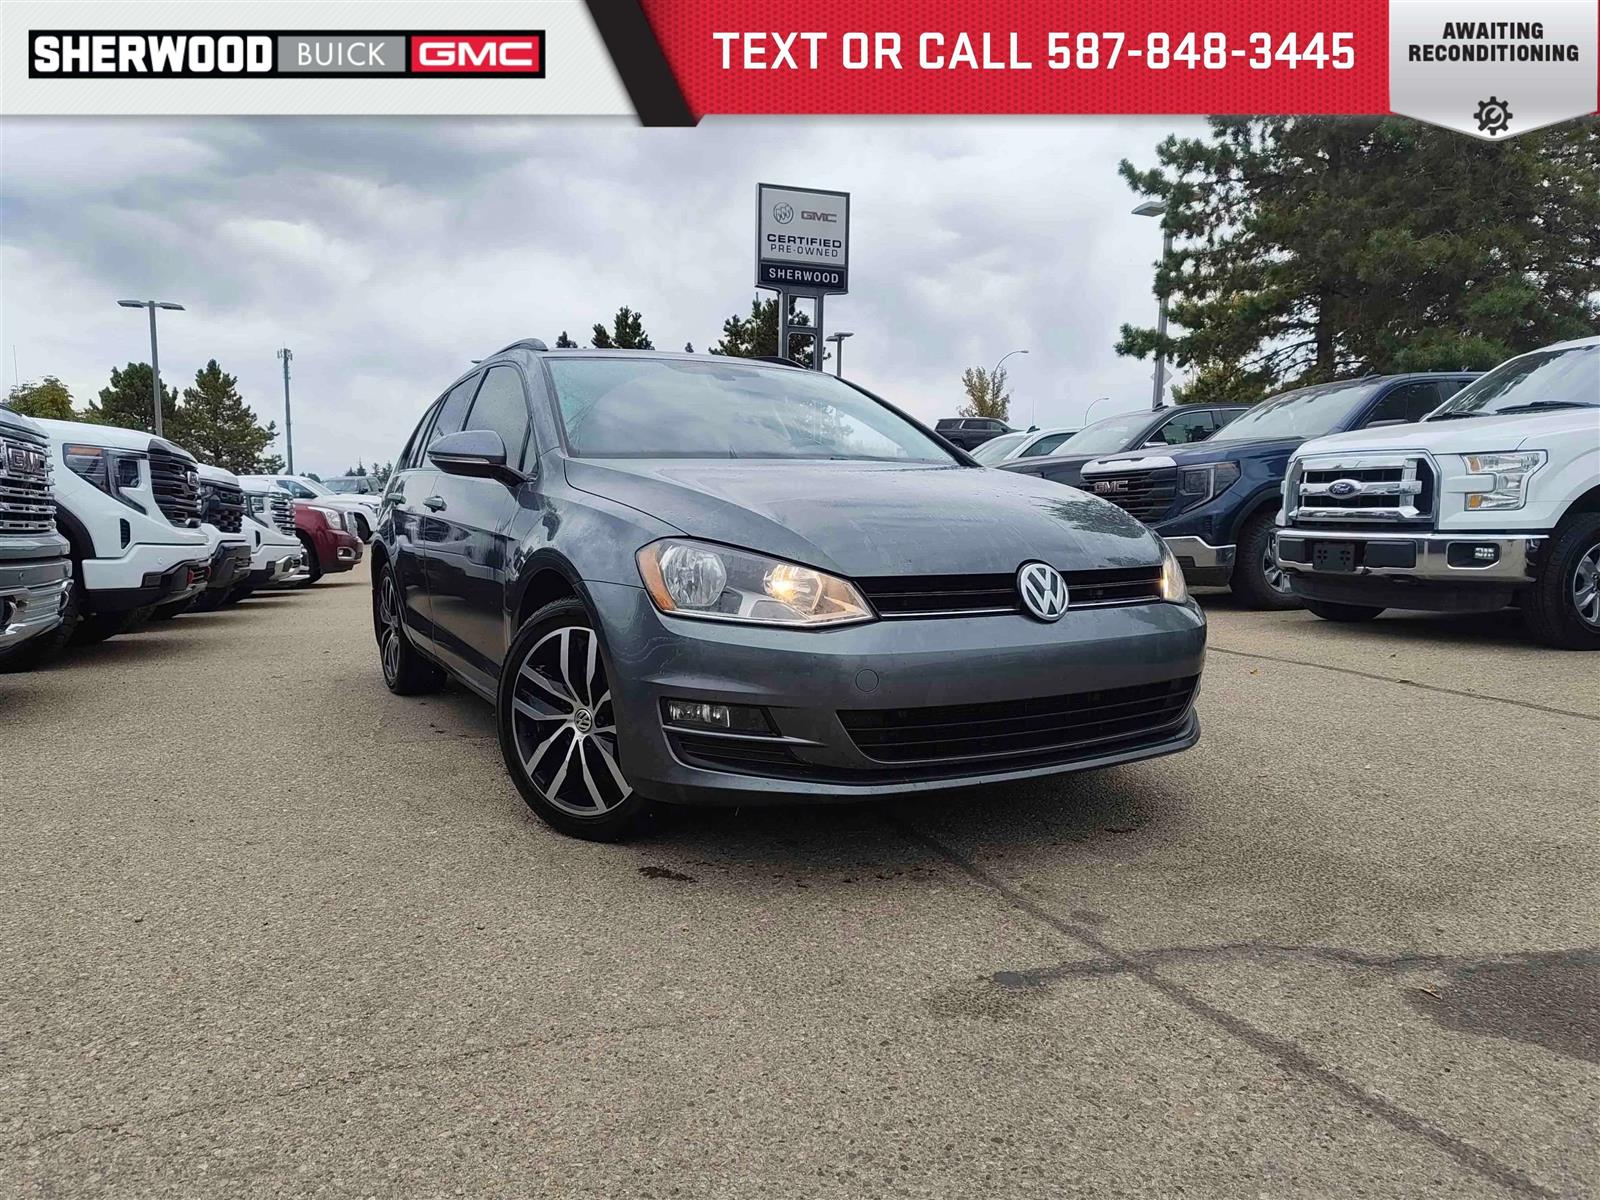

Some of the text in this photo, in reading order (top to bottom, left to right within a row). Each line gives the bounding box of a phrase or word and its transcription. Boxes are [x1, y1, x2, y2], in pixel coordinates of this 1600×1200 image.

[801, 210, 837, 223] GMC
[767, 233, 842, 249] CERTIFIED
[770, 243, 838, 258] PRE-OWNED
[769, 267, 839, 284] SHERWOOD
[1094, 480, 1129, 493] GMC
